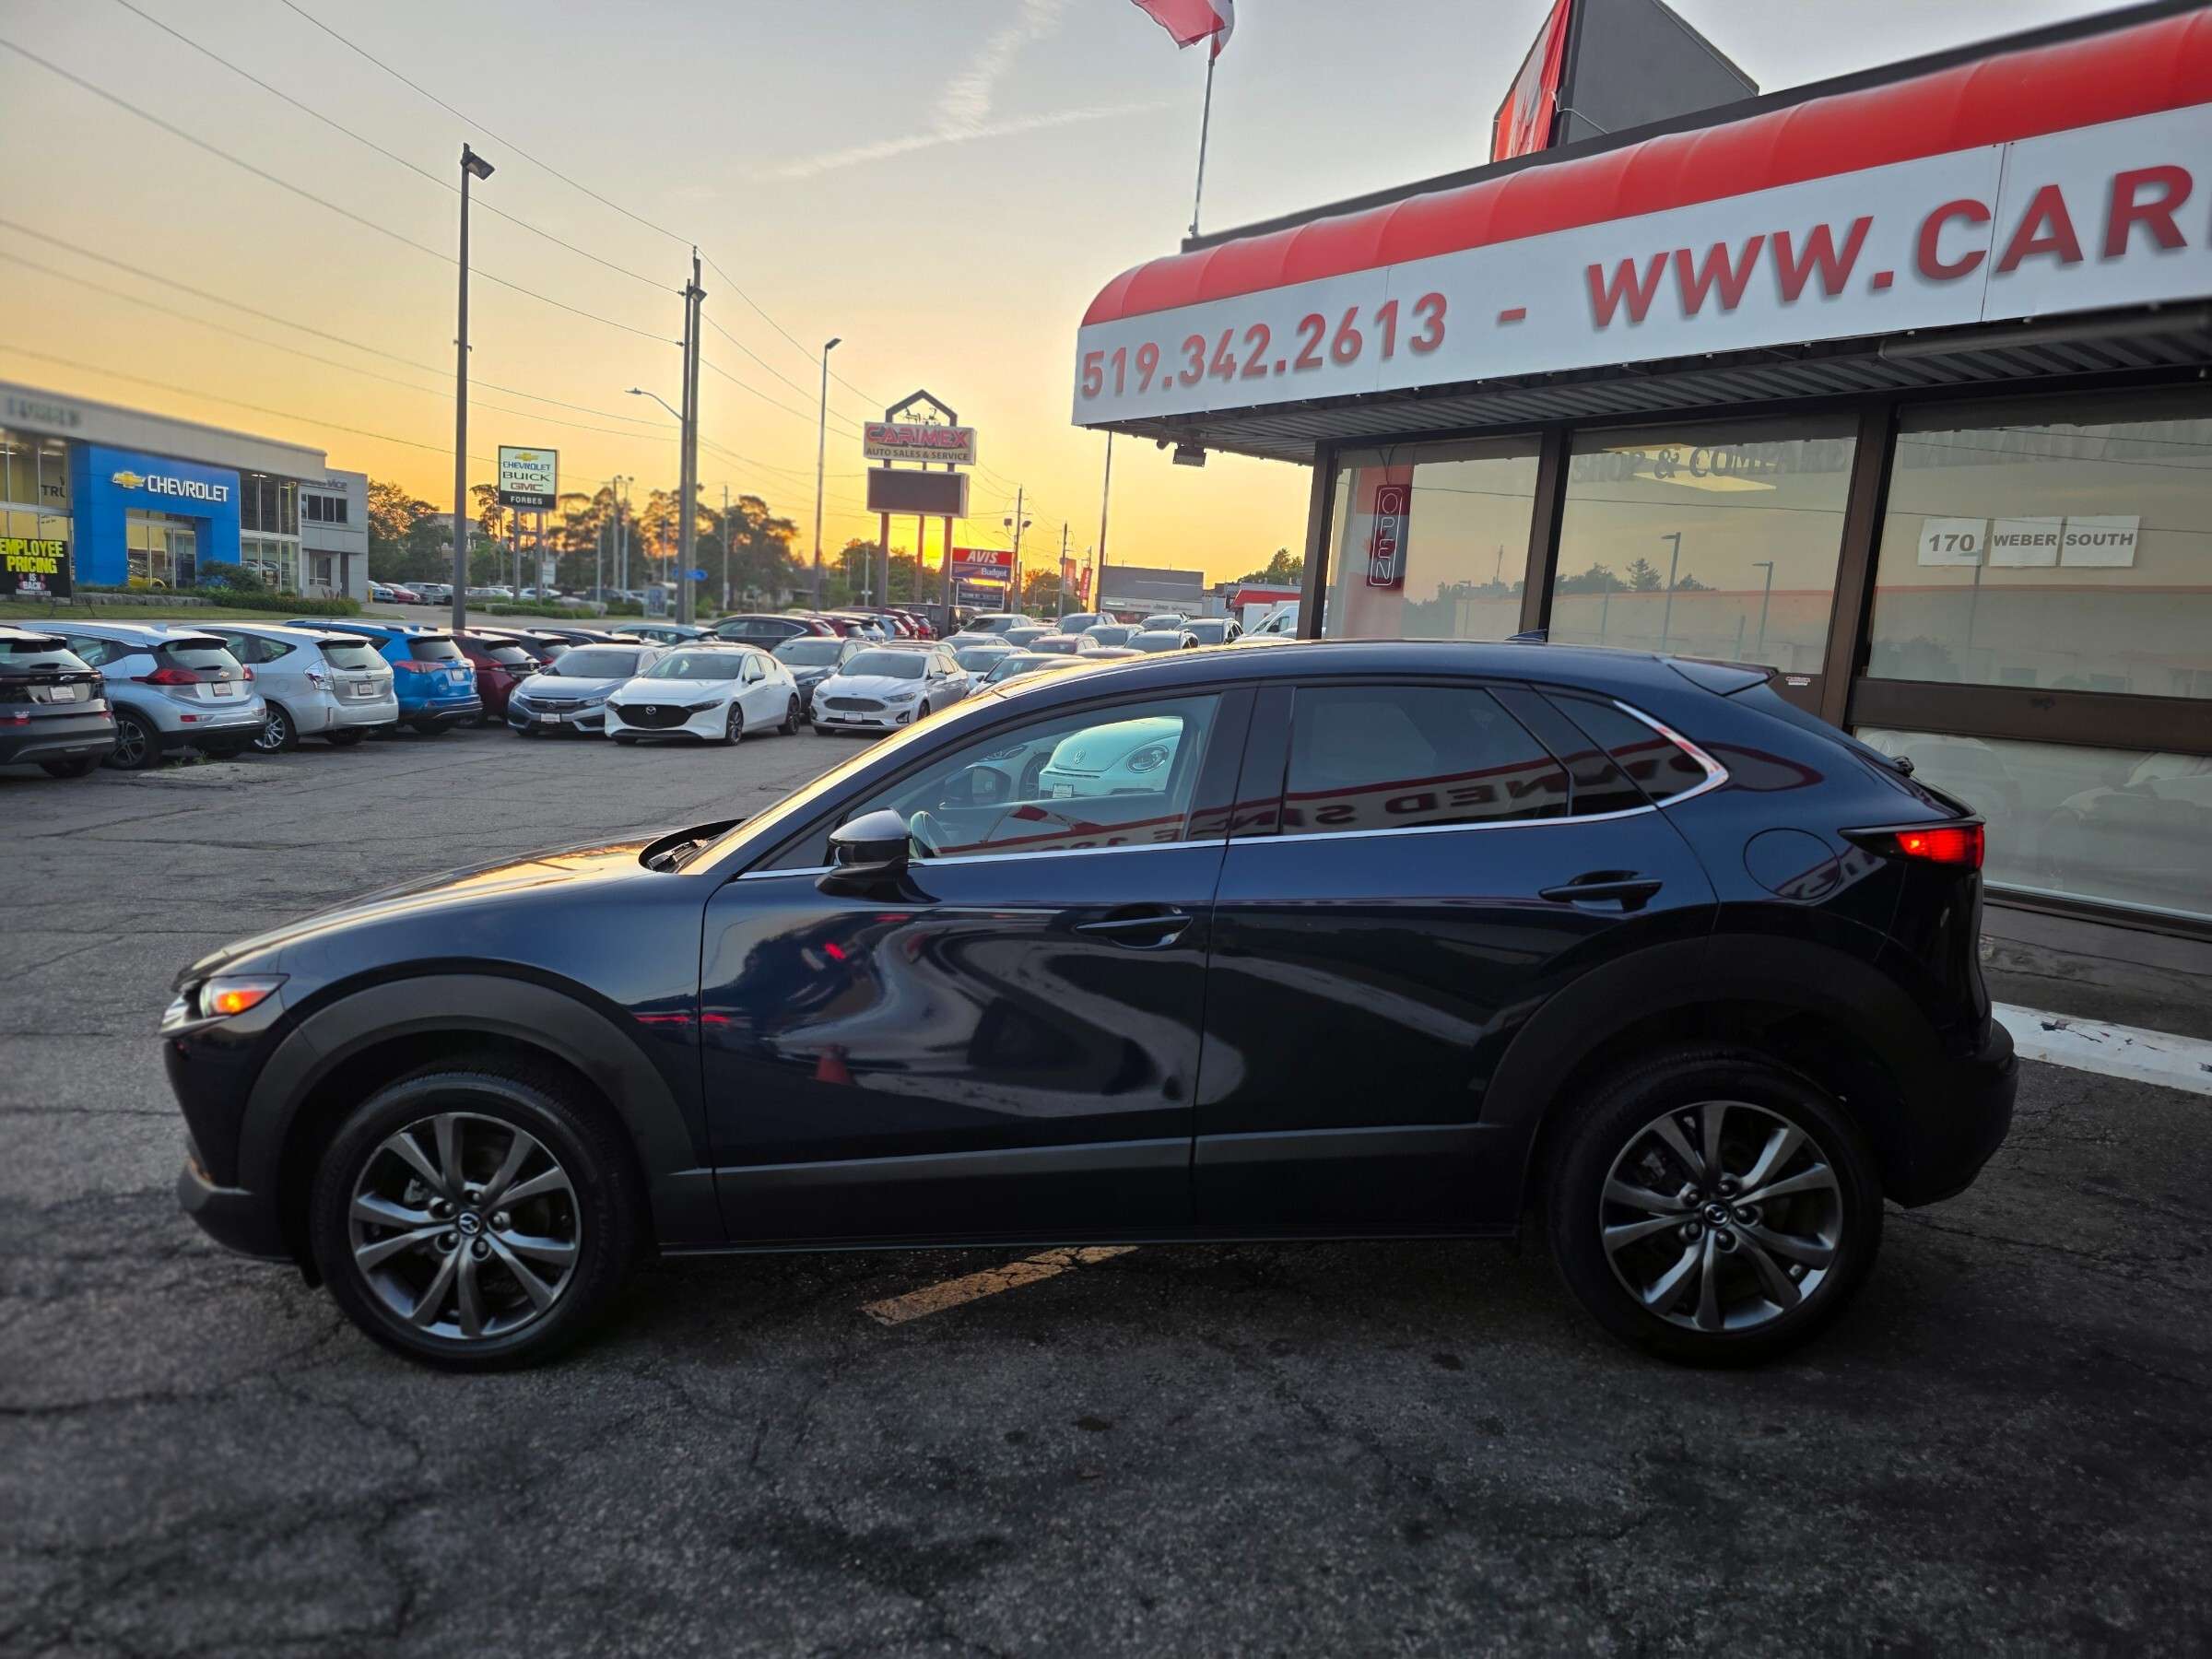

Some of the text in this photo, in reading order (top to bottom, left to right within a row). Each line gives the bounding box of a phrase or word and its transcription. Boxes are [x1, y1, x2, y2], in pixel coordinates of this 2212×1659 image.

[1082, 292, 1447, 397] 519.342.2613
[1585, 165, 2212, 328] WWW.CAR
[867, 425, 969, 448] CARIMEX
[866, 448, 891, 456] AUTO
[893, 450, 920, 458] SALES
[932, 452, 969, 460] SERVICE
[502, 461, 551, 471] CHEVROLET
[502, 471, 551, 482] BUICK
[147, 475, 229, 502] CHEVROLET
[510, 482, 544, 492] GMC
[510, 496, 543, 505] FORBES
[1375, 492, 1398, 580] OPEN
[0, 538, 65, 557] EMPLOYEE
[1929, 533, 2134, 552] 170 WEBER SOUTH
[966, 550, 998, 563] AVIS
[6, 556, 58, 573] PRICING
[29, 573, 37, 582] IS
[981, 567, 1007, 578] Budget
[22, 581, 42, 590] BACK
